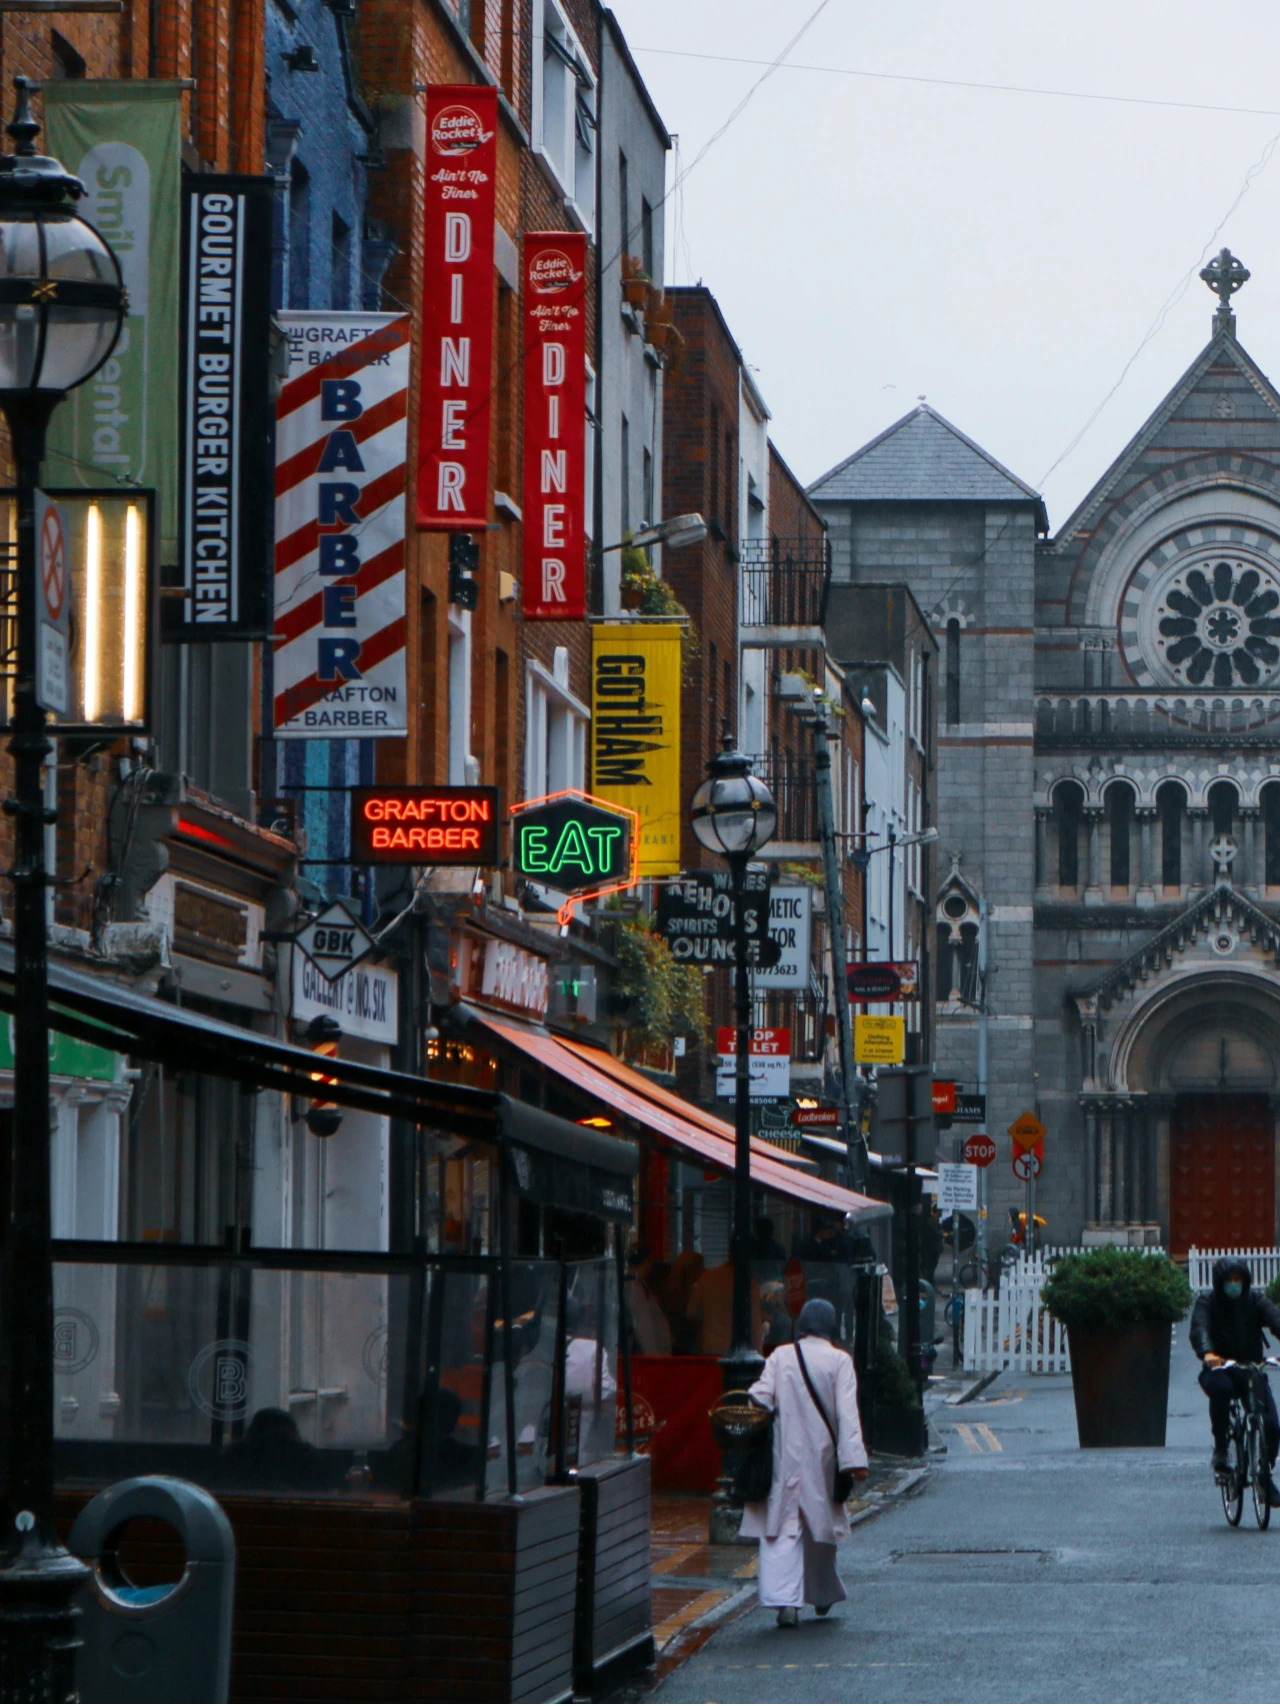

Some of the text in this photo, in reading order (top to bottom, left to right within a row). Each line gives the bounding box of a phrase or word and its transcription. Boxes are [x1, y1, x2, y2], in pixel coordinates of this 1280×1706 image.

[440, 115, 476, 129] Eddie
[432, 125, 484, 140] Rocket's
[431, 168, 489, 185] Ain't No
[441, 185, 479, 200] Finer
[536, 258, 567, 271] Eddie
[530, 266, 574, 281] Rocket's
[530, 304, 560, 318] Ain't
[539, 319, 571, 332] Finer
[305, 328, 402, 343] GRAFTON
[289, 327, 304, 366] THE
[308, 350, 391, 367] BARBER
[437, 211, 472, 513] DINER
[195, 193, 234, 623] GOURMET BURGER KITCHEN
[540, 342, 567, 603] DINER
[316, 379, 366, 681] BARBER
[305, 710, 389, 727] BARBER
[596, 654, 672, 787] GOTHAM
[364, 799, 490, 823] GRAFTON
[372, 828, 481, 850] BARBER
[521, 821, 621, 874] EAT
[713, 873, 767, 891] WIES
[664, 876, 758, 934] KEHOS
[667, 918, 718, 934] SPIRITS
[313, 929, 355, 955] GBK
[733, 1030, 774, 1042] SOP
[752, 1042, 780, 1053] LET
[797, 1111, 836, 1122] Ladbrokes
[965, 1145, 996, 1158] STOP
